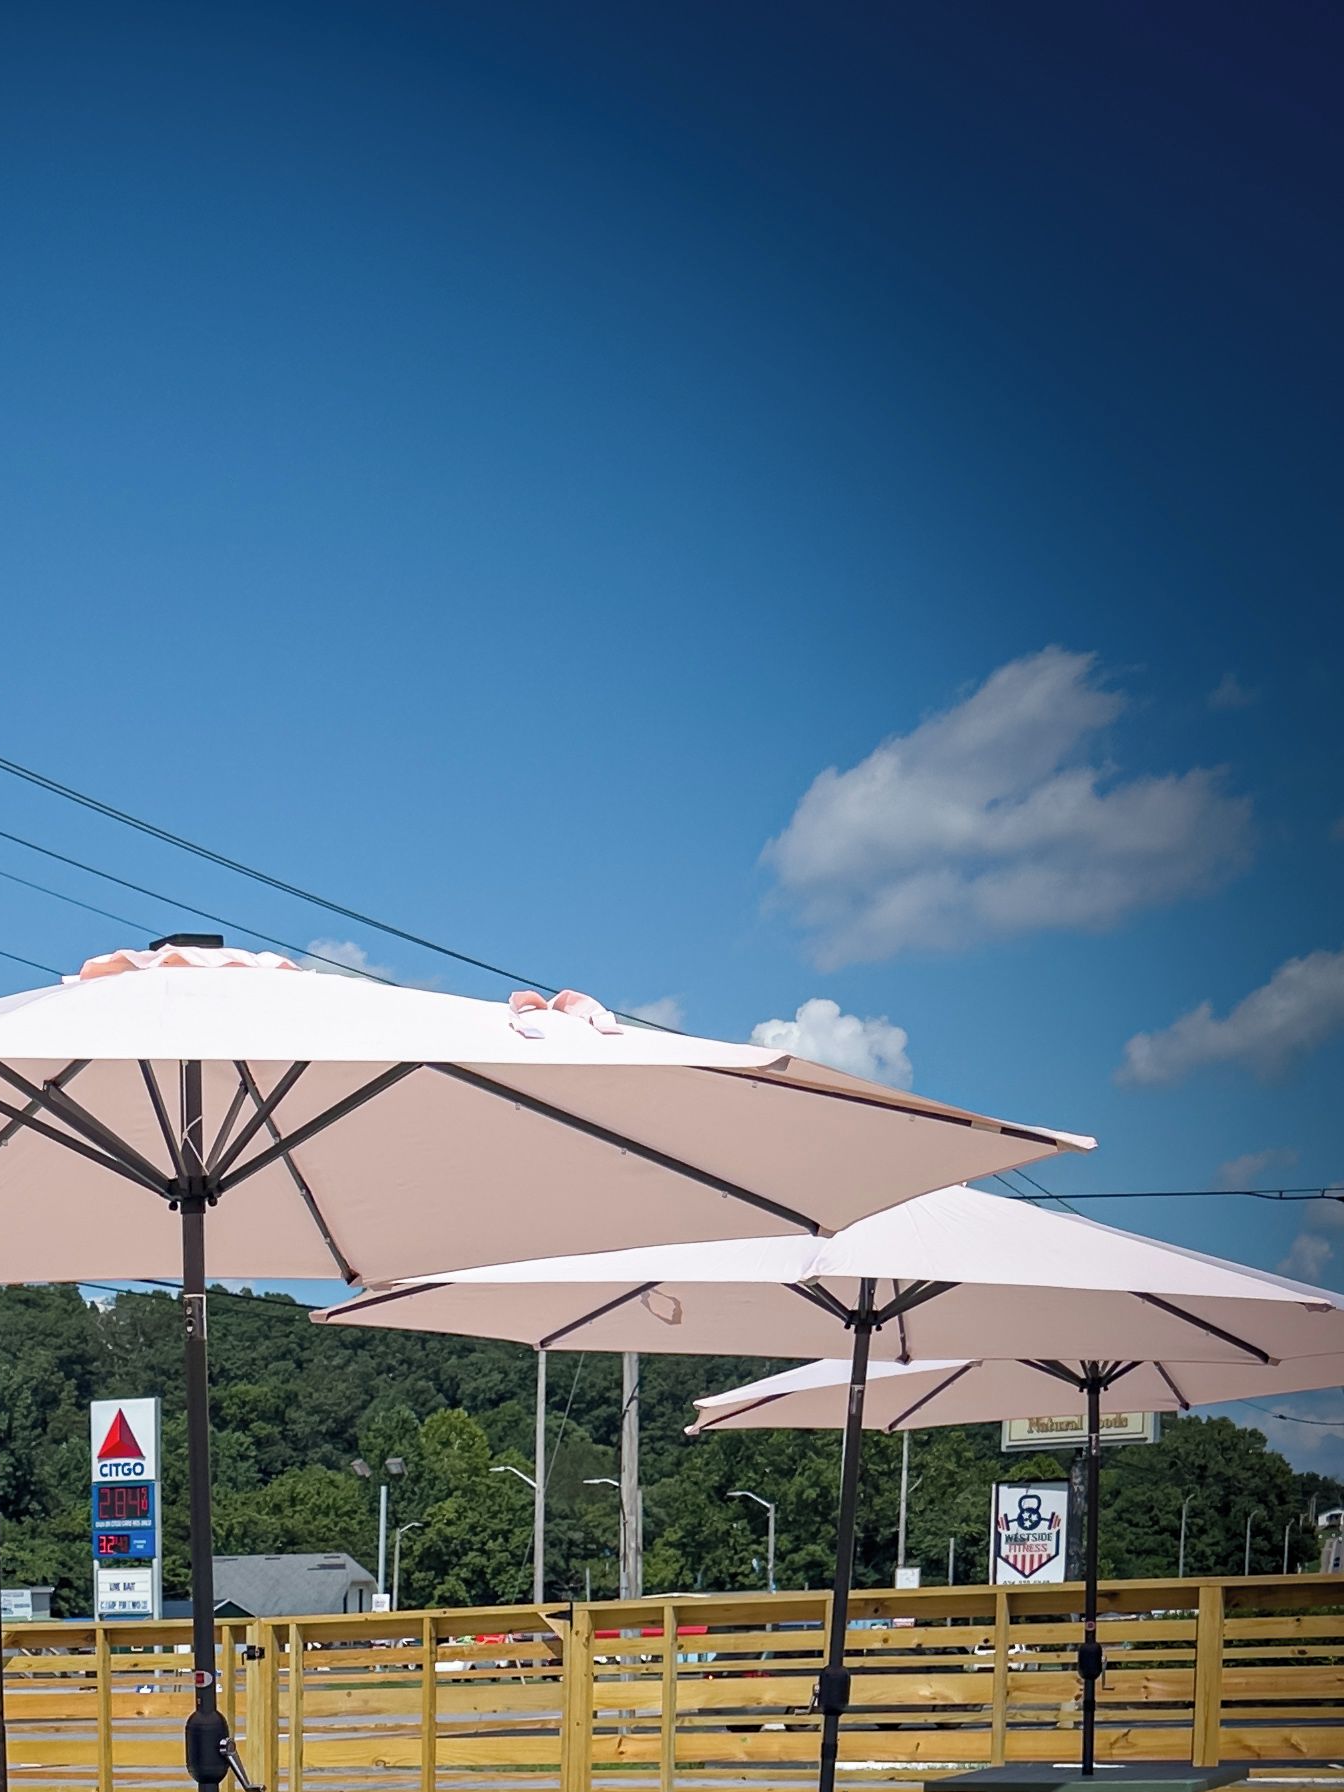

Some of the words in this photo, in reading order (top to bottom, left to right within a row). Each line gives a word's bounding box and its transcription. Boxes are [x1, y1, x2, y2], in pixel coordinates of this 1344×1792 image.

[1098, 1412, 1129, 1430] oods
[99, 1462, 145, 1478] CITGO
[1004, 1532, 1053, 1544] WESTSIDE
[1008, 1543, 1048, 1553] FITNESS
